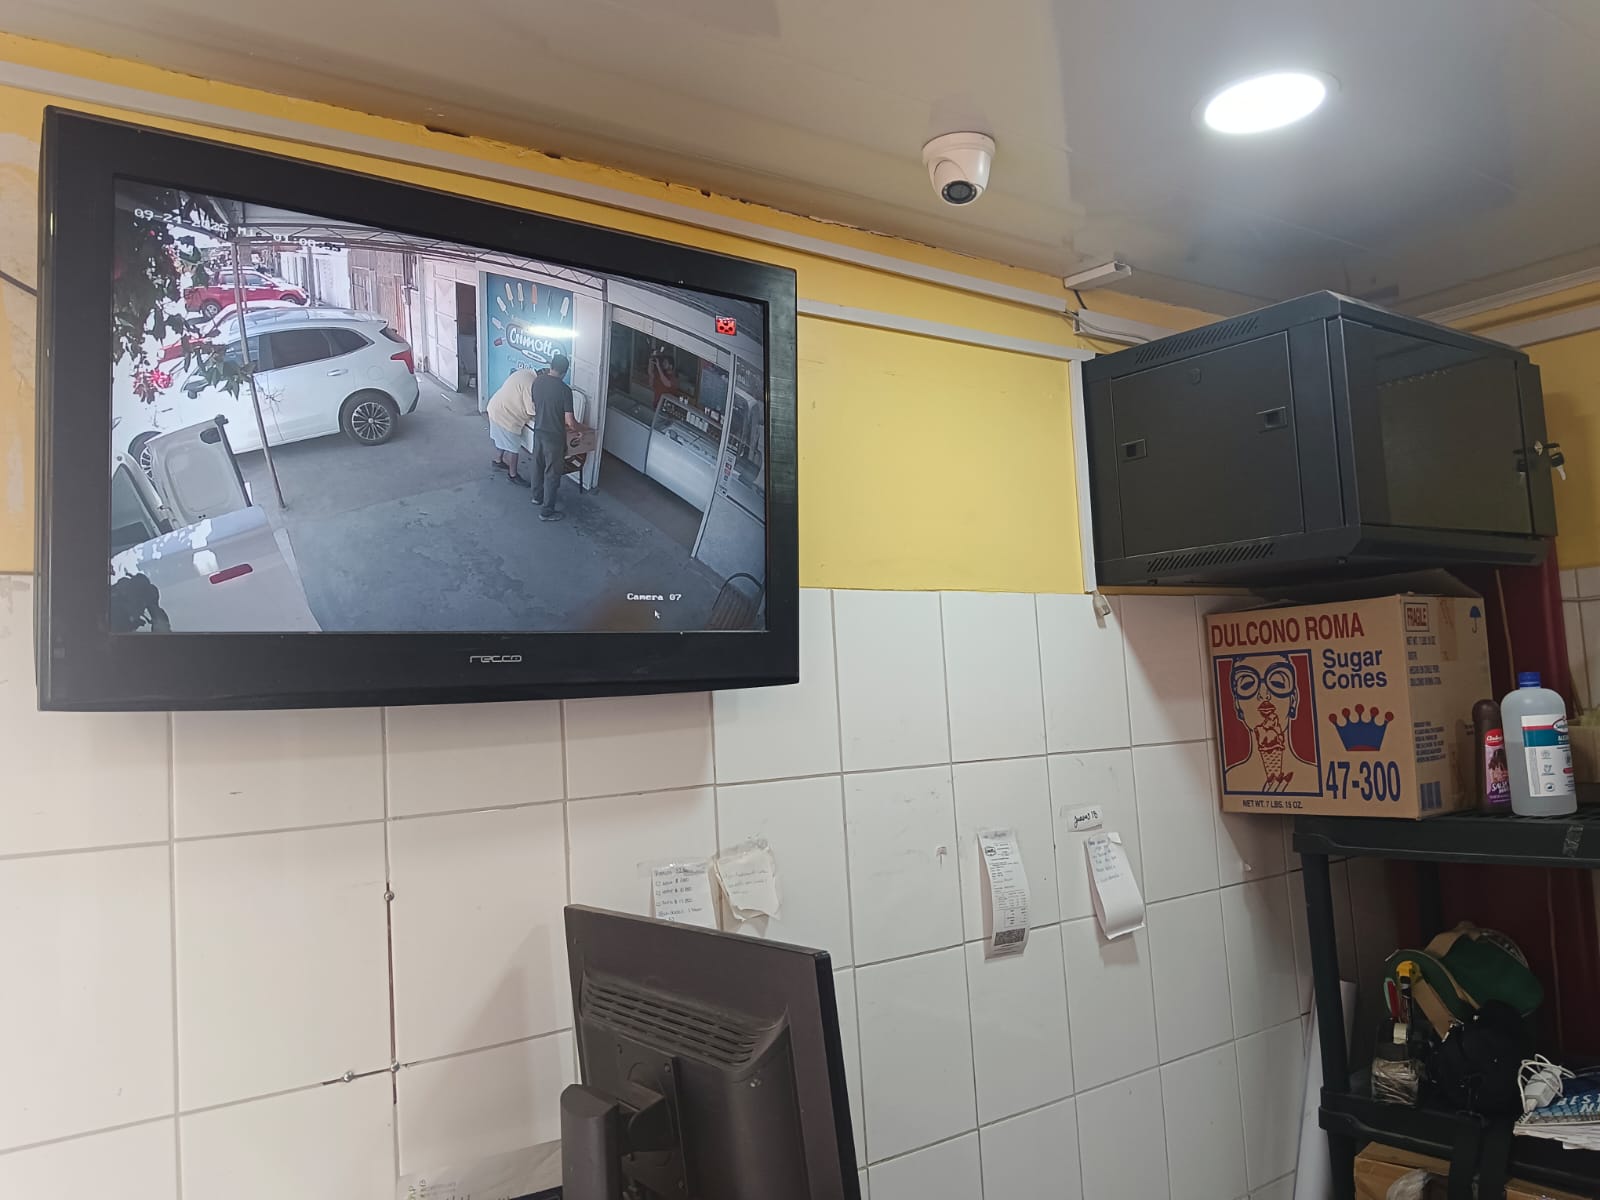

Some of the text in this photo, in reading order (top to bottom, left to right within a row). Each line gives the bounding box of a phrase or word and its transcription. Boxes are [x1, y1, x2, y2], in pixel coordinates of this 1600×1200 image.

[626, 592, 682, 601] Camera 07
[1406, 607, 1428, 627] FRAGILE
[1211, 612, 1365, 648] DULCONO ROMA
[1322, 648, 1383, 672] Sugar
[1322, 669, 1388, 689] Cones
[1326, 760, 1401, 802] 47-300
[1242, 799, 1254, 808] NET
